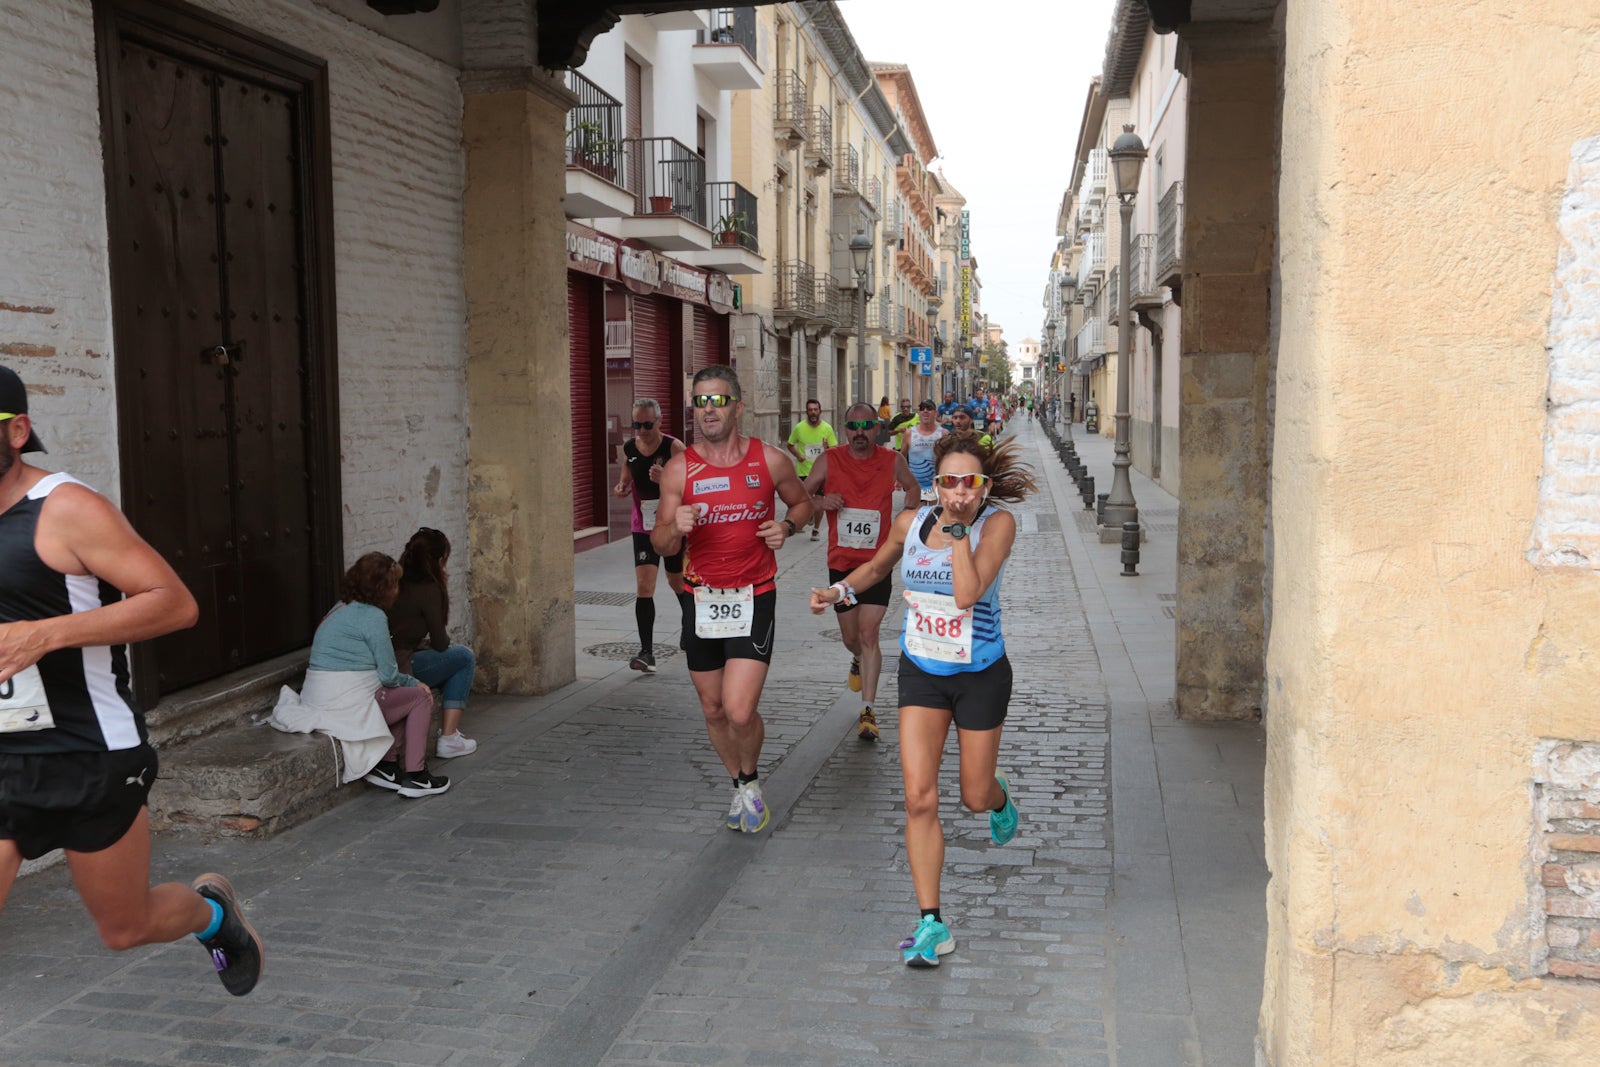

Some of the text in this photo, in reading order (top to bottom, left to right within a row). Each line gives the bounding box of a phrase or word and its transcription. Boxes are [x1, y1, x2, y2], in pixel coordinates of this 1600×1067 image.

[961, 211, 970, 259] TEJIDOS
[961, 267, 970, 347] CONFECCION
[846, 522, 871, 536] 146
[906, 569, 952, 580] MARACE
[709, 603, 742, 620] 396
[915, 612, 962, 639] 2188
